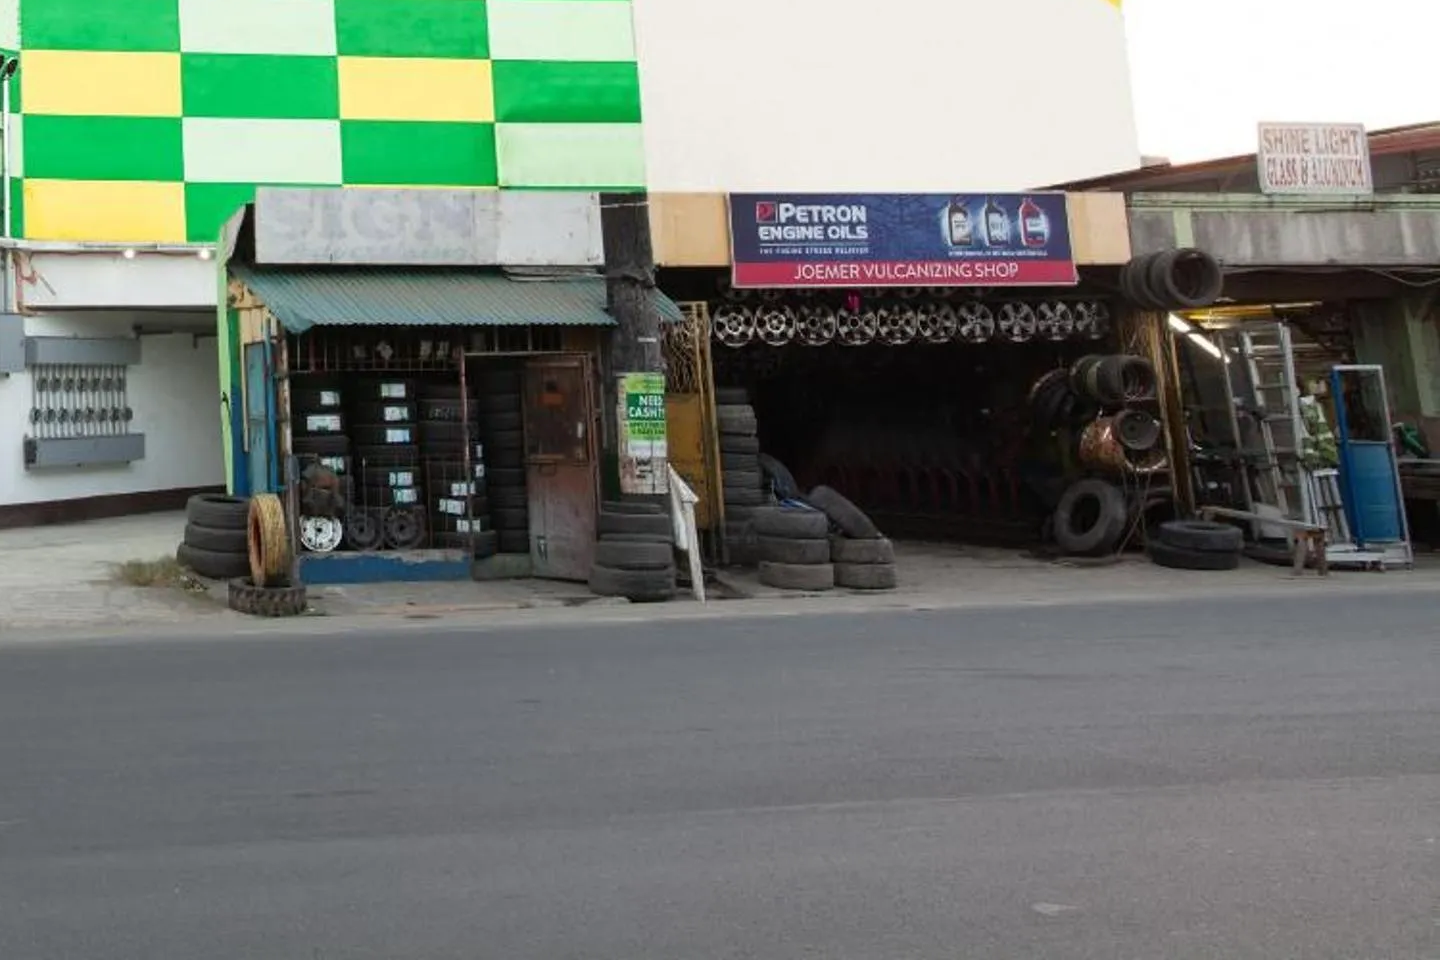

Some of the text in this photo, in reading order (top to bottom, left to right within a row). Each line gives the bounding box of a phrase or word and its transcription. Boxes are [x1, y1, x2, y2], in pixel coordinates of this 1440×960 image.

[778, 202, 867, 223] PETRON
[758, 225, 869, 240] ENGINE OILS
[794, 262, 1019, 279] JOEMER VULCANIZING SHOP
